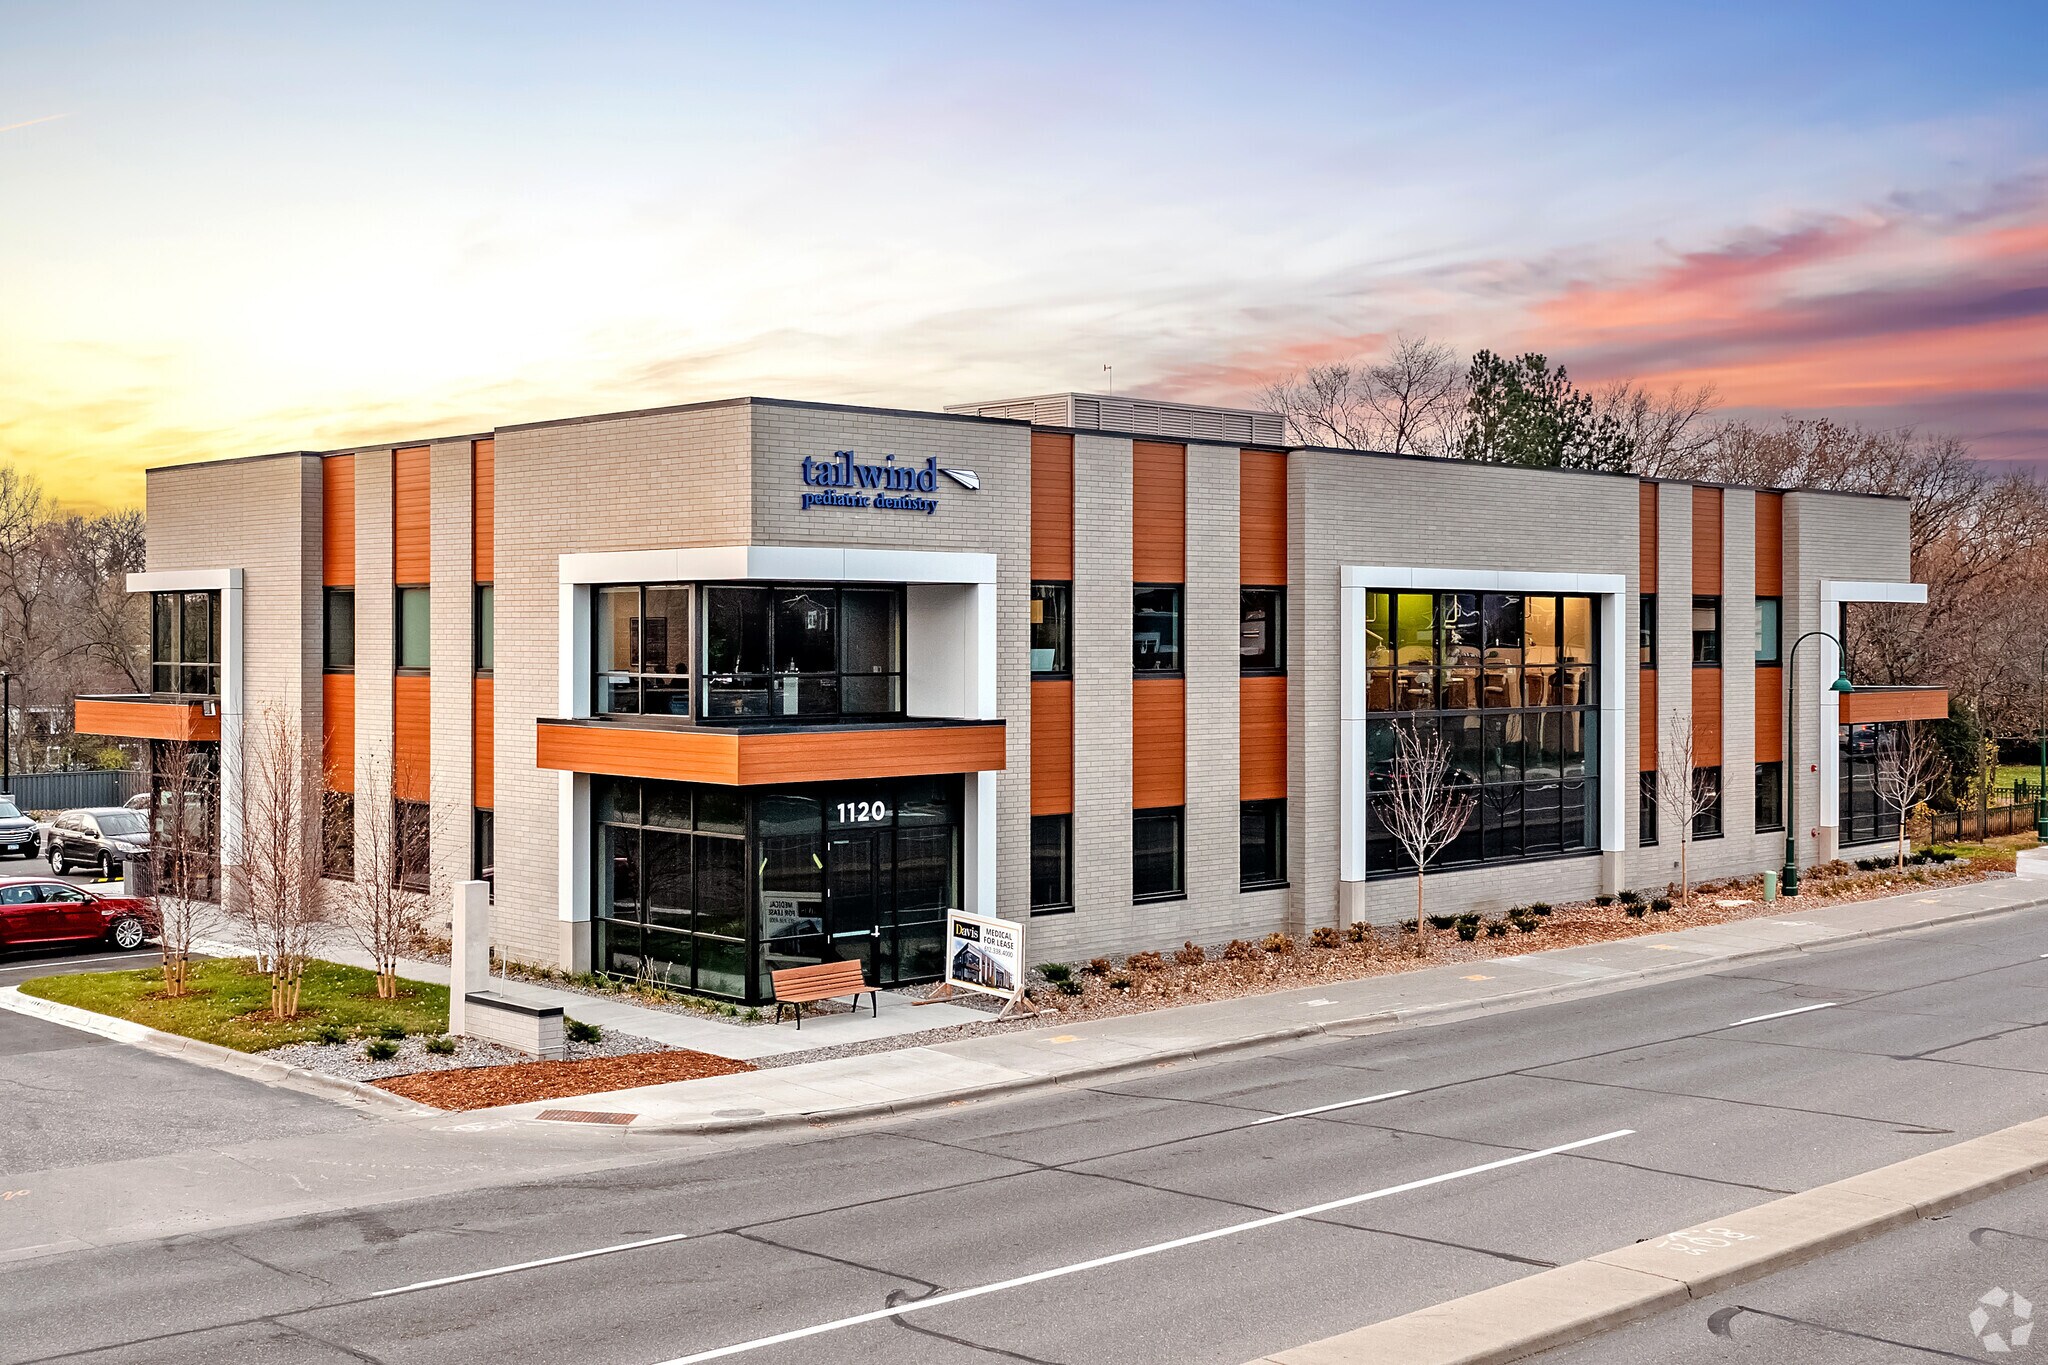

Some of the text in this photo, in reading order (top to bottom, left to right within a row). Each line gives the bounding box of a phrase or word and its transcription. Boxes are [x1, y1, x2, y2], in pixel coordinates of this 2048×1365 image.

[801, 450, 939, 492] tailwind
[802, 489, 939, 515] pediatric dentistry
[837, 800, 886, 823] 1120
[956, 924, 978, 938] Davis
[986, 928, 1012, 940] MEDICAL
[984, 937, 1014, 950] FOR LEASE
